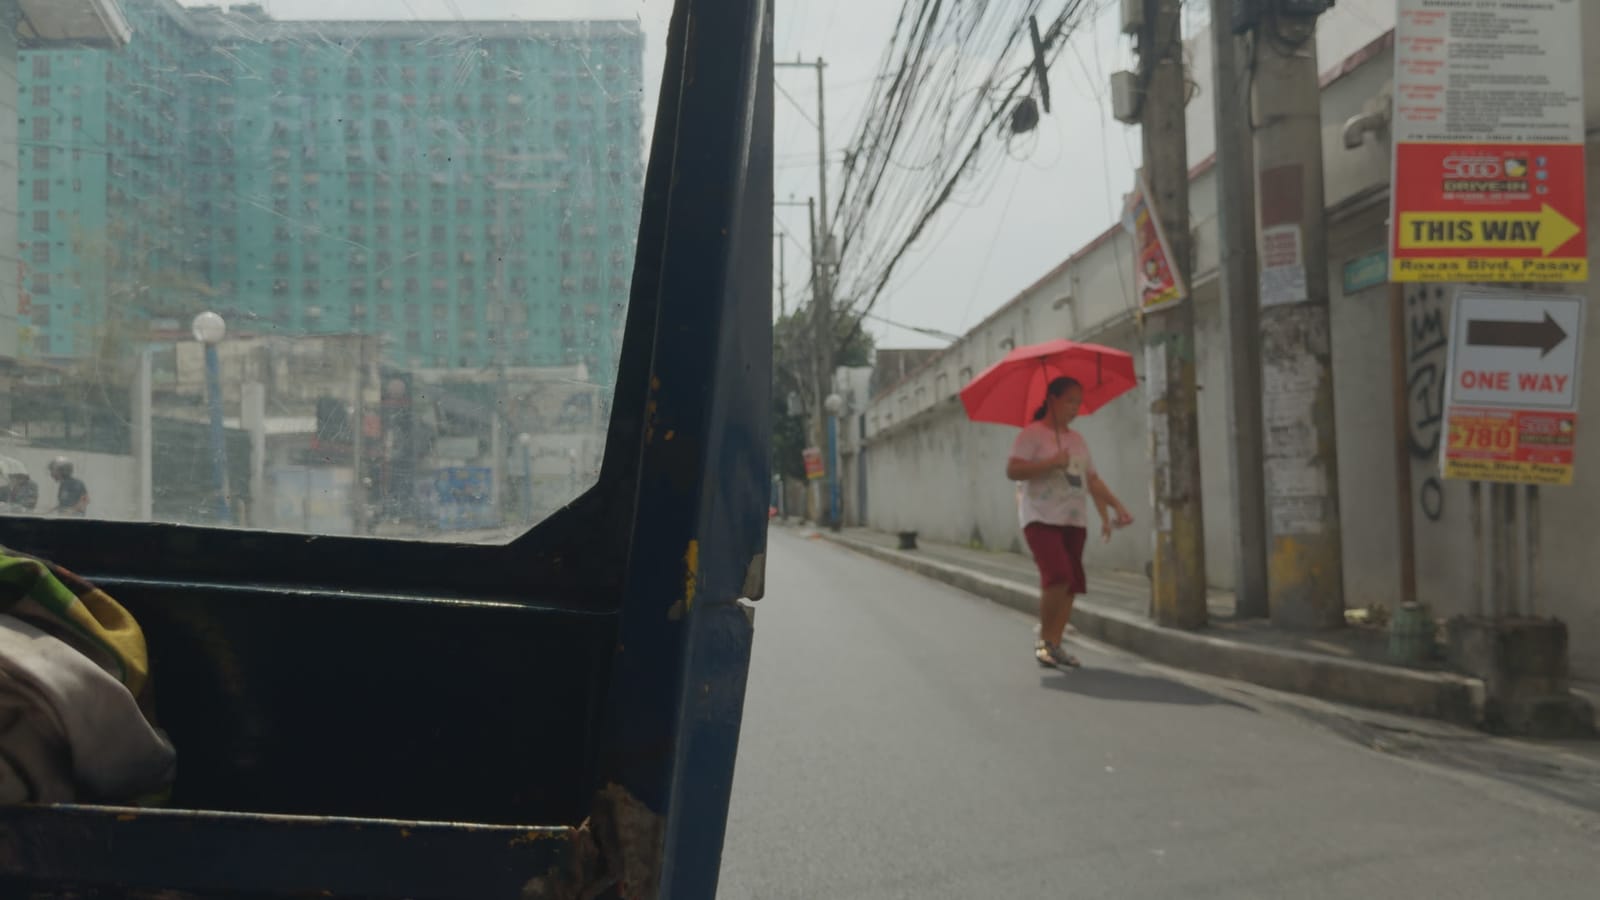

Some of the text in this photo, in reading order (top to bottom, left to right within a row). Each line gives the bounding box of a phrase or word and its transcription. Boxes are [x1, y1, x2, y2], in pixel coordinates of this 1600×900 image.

[1411, 220, 1541, 242] THIS WAY
[1400, 260, 1459, 271] Roxas
[1522, 260, 1581, 274] Pasay
[1460, 371, 1569, 394] ONE WAY
